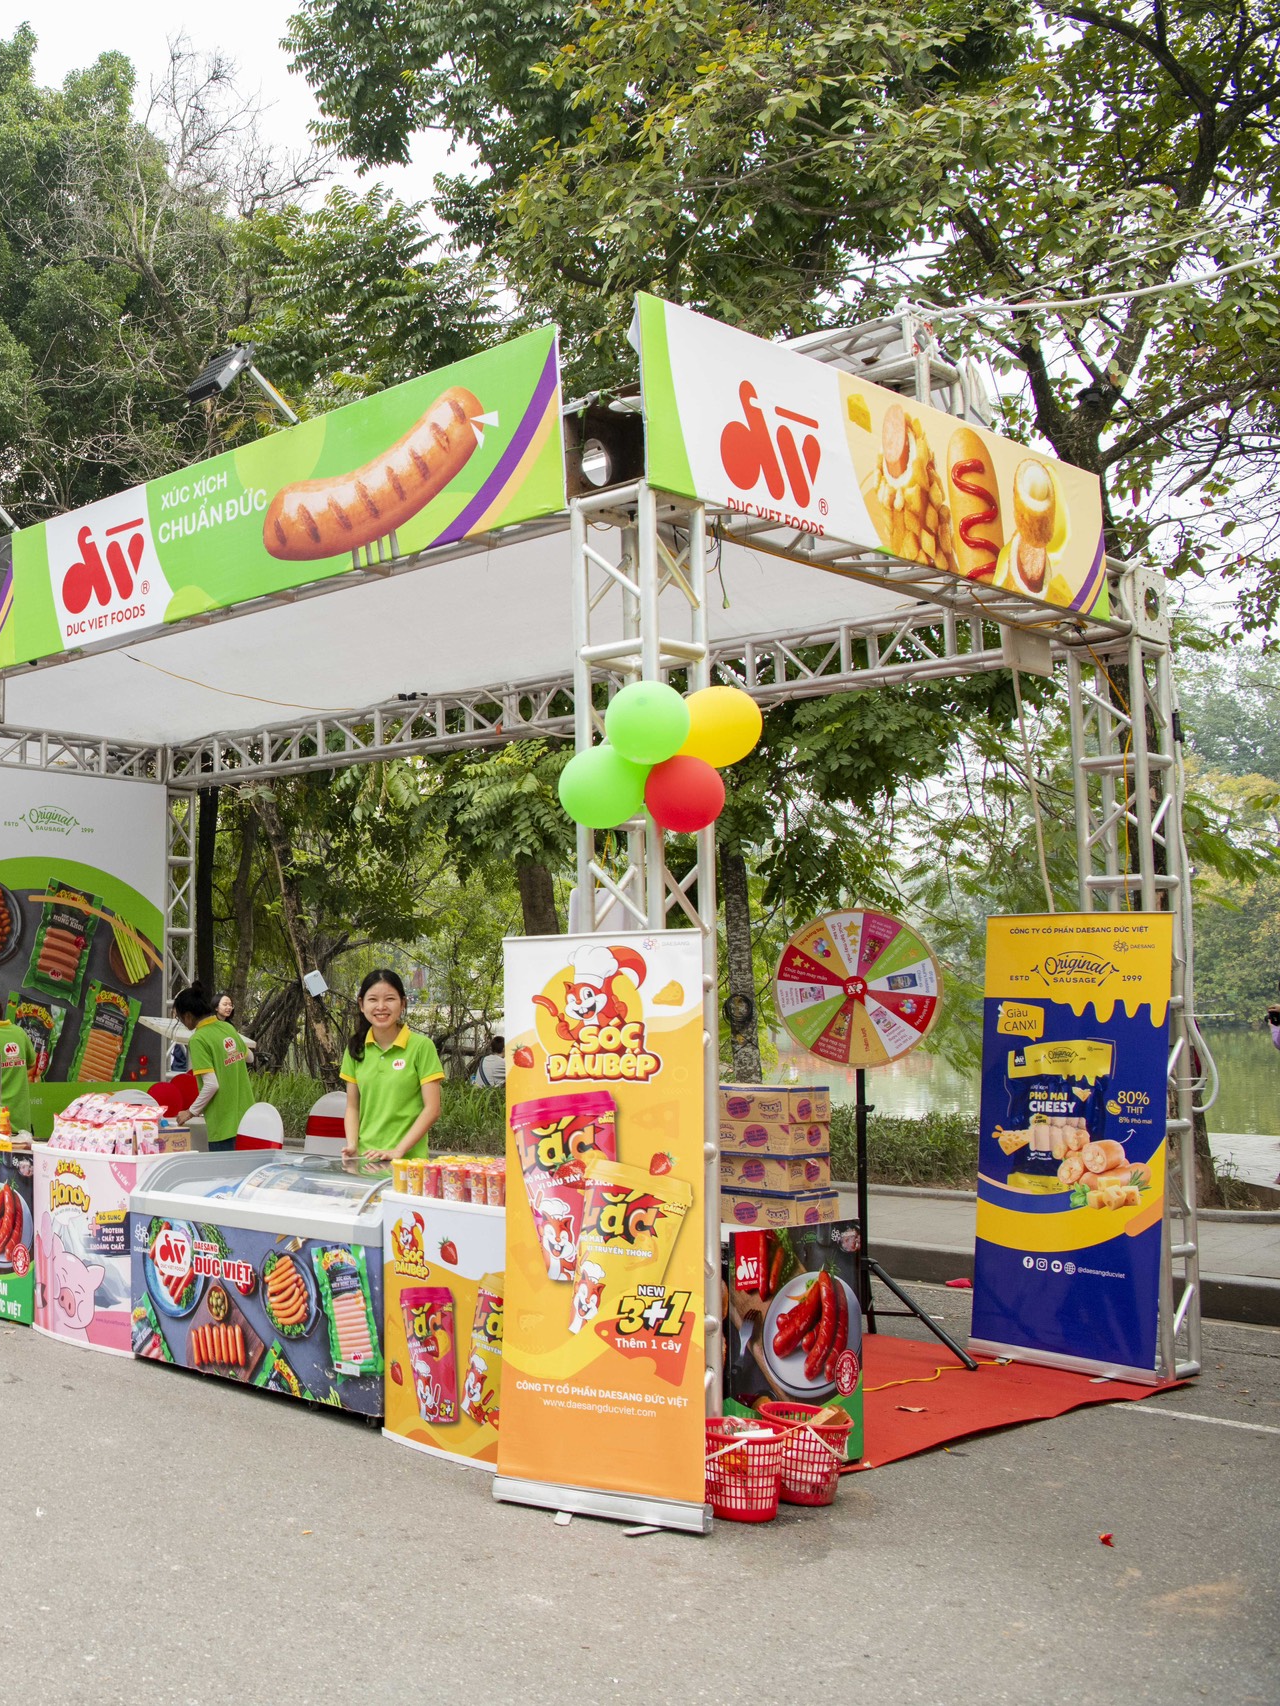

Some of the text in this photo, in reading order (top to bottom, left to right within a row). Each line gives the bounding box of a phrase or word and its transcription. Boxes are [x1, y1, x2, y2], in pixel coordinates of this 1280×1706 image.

[161, 471, 228, 511] XÚC XÍCH
[158, 489, 267, 544] CHUẨN ĐỨC
[67, 604, 145, 637] DUC VIET FOODS
[29, 808, 74, 826] Original
[35, 825, 65, 833] SAUSAGE
[1009, 927, 1030, 935] CÔNG
[1075, 926, 1112, 934] DAESANG
[1113, 925, 1130, 933] ĐỨC
[1131, 925, 1149, 934] VIỆT
[1044, 955, 1111, 976] Original
[1006, 1008, 1029, 1018] Giàu
[1004, 1019, 1037, 1032] CANXI
[578, 1016, 643, 1054] SÓC
[1050, 1091, 1068, 1101] MAI
[1117, 1090, 1150, 1106] 80%
[1028, 1101, 1077, 1113] CHEESY
[1126, 1105, 1144, 1116] THỊT
[534, 1172, 550, 1182] MAI
[563, 1172, 582, 1185] TÂY
[50, 1178, 91, 1214] Handy
[193, 1241, 218, 1253] DAESANG
[589, 1235, 605, 1244] MAI
[194, 1256, 251, 1285] ĐỨC VIỆT
[1077, 1266, 1126, 1280] @daesangducviet
[638, 1285, 666, 1298] NEW
[6, 1300, 22, 1319] VIỆT
[616, 1291, 692, 1337] 3+1
[615, 1337, 682, 1354] Thêm 1 cây
[515, 1379, 689, 1408] CÔNG TY CỔ PHẦN DAESANG ĐỨC VIỆT
[440, 1402, 455, 1418] 3+1
[542, 1399, 657, 1418] www.daesangducviet.com
